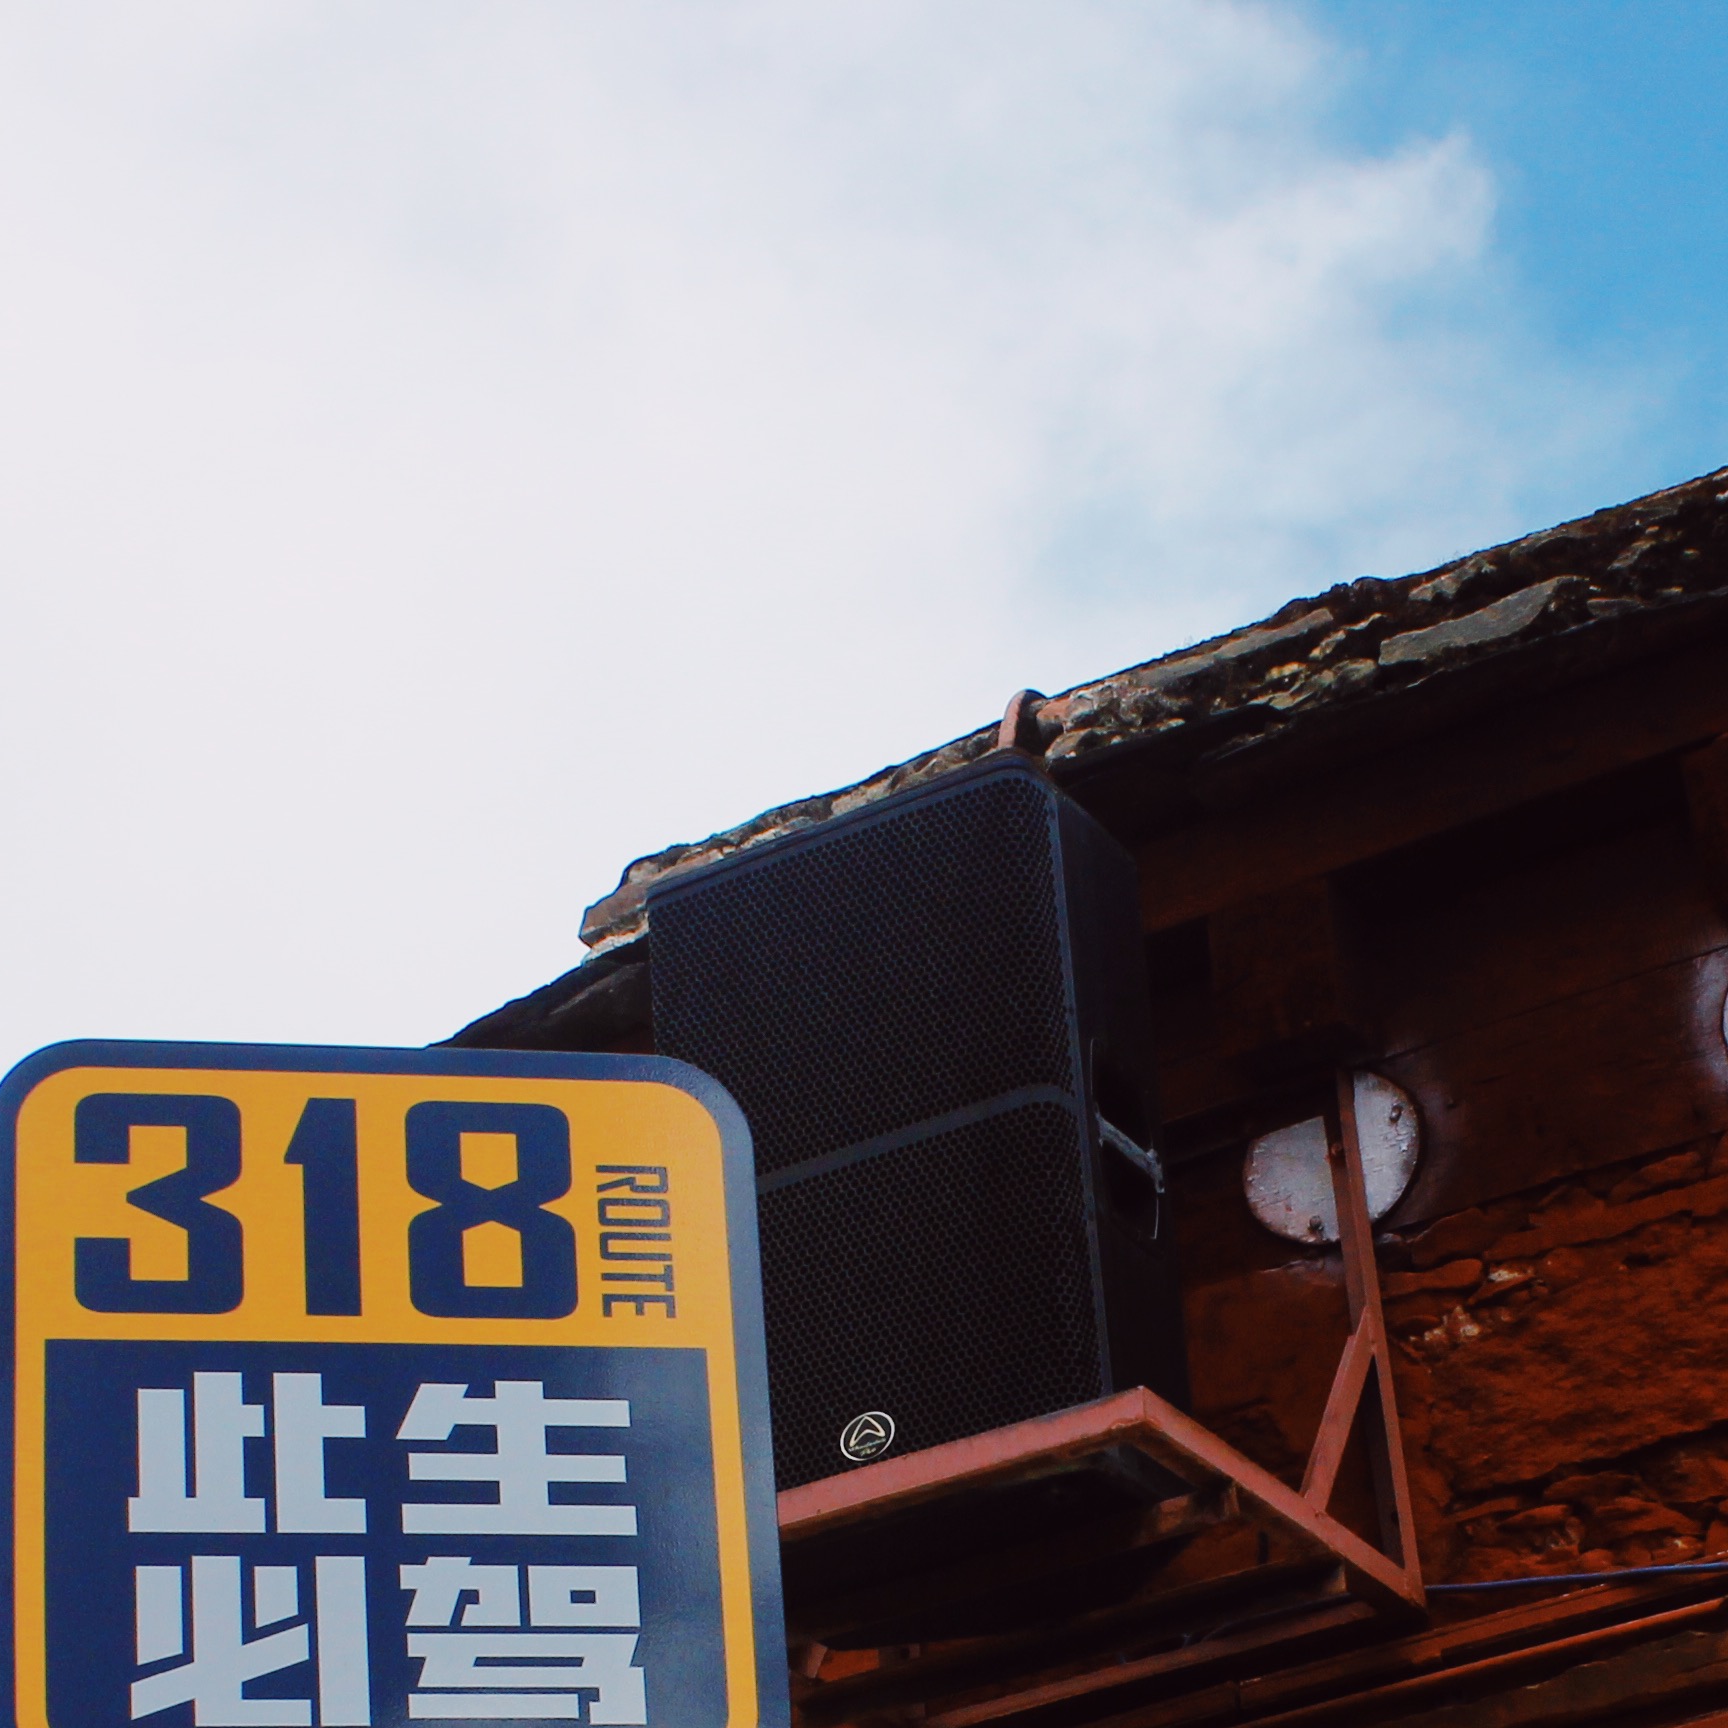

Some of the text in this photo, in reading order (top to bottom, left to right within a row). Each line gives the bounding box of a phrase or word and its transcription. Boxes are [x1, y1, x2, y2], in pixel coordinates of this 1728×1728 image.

[74, 1092, 579, 1321] 318
[594, 1163, 677, 1319] ROUTE
[127, 1371, 639, 1537] 此生
[129, 1554, 649, 1727] 必驾
